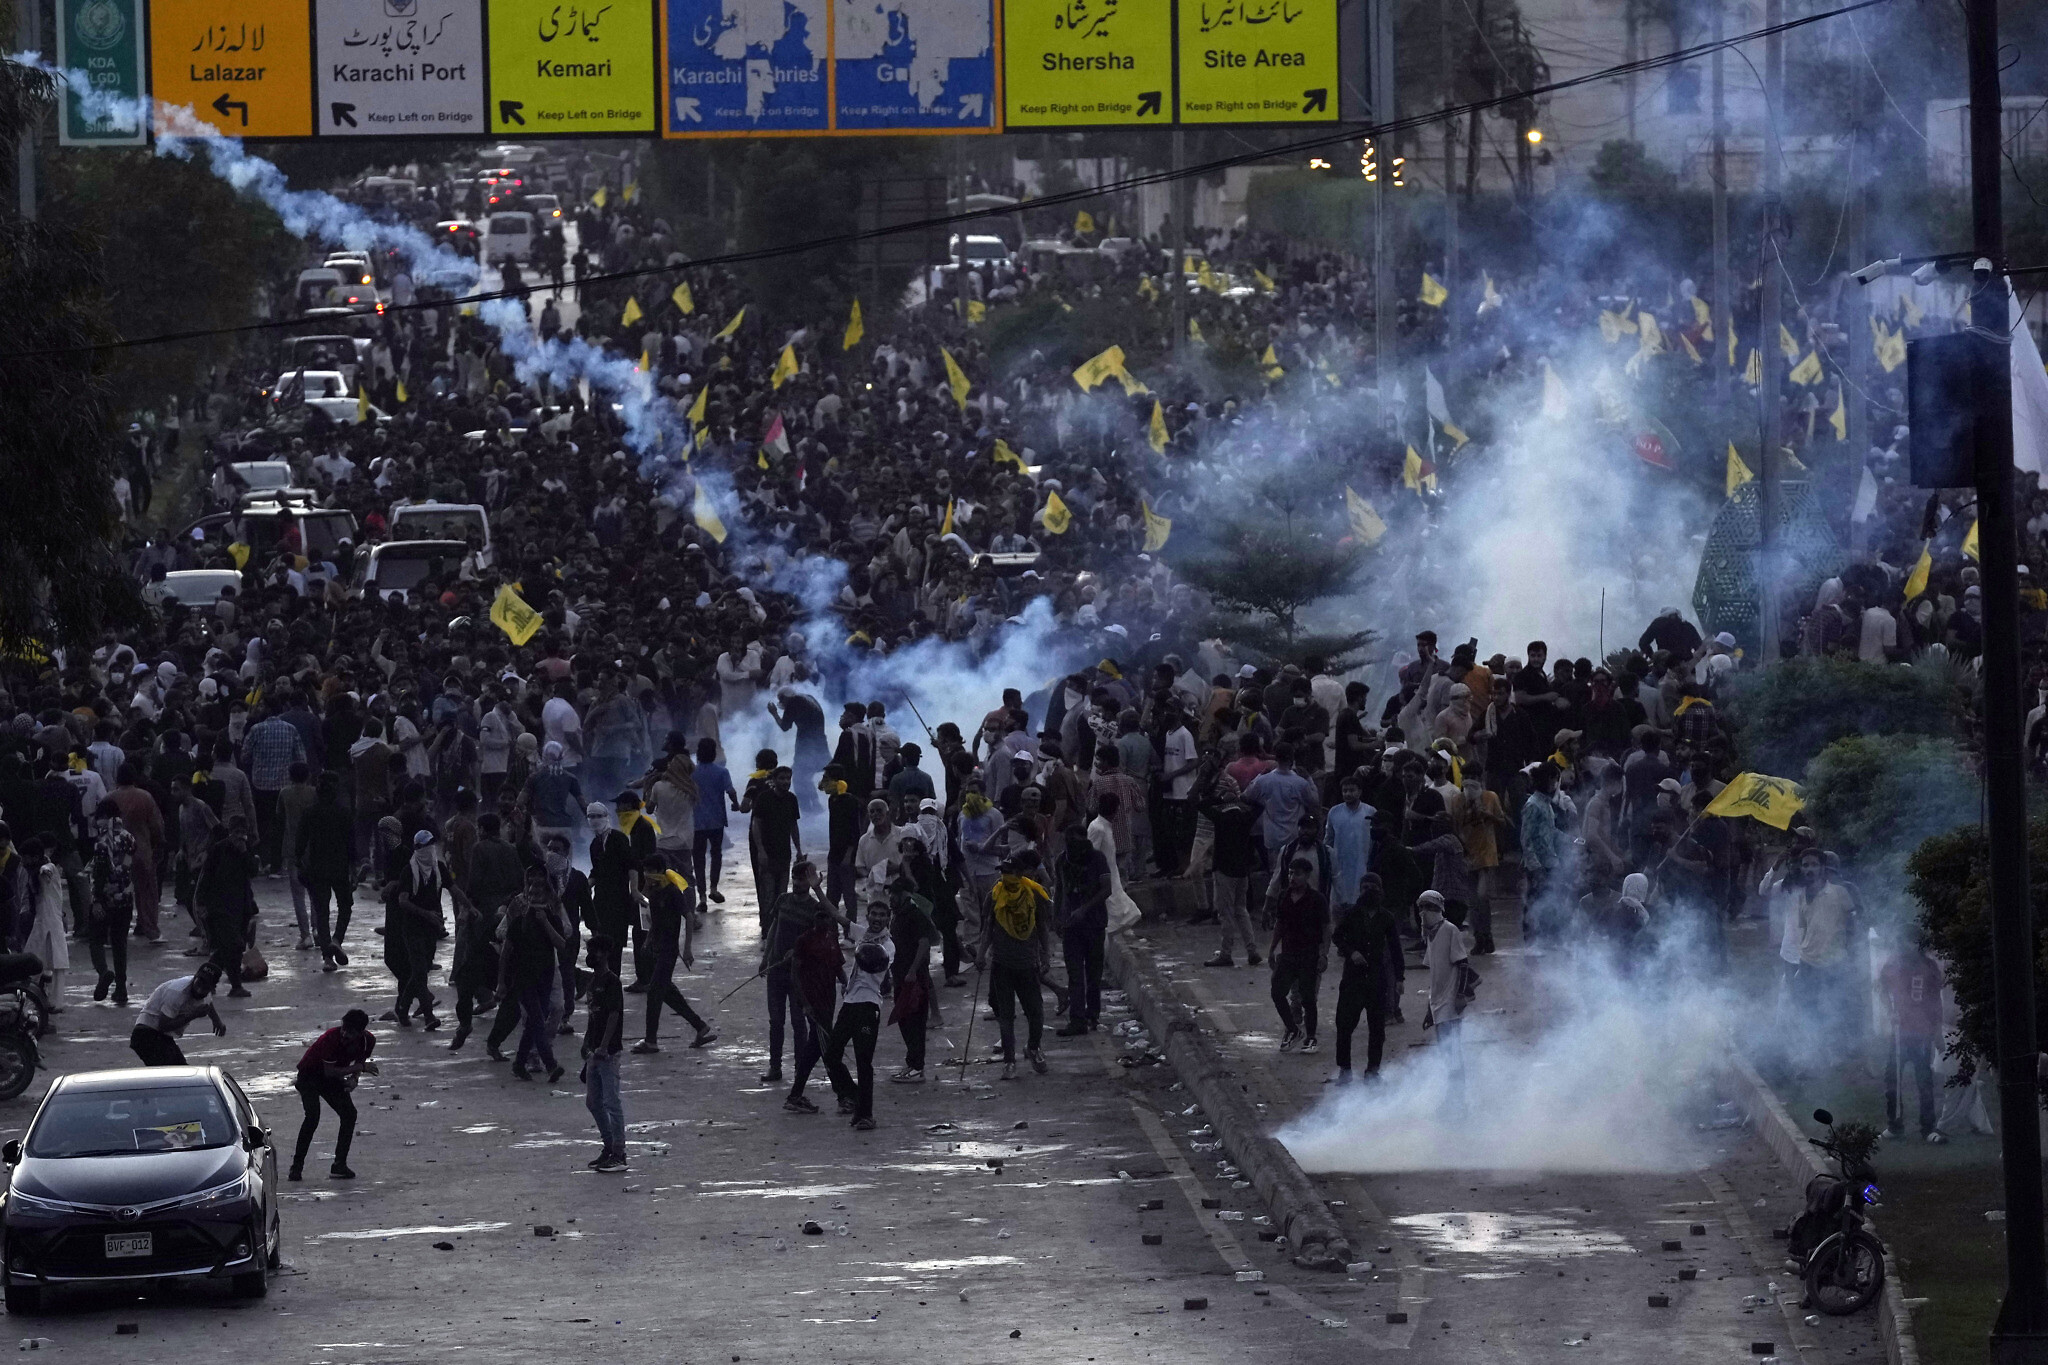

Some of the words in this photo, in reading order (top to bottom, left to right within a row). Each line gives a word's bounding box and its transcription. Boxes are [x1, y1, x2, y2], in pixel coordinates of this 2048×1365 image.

[396, 12, 454, 56] کراچی
[344, 26, 392, 58] پورٹ
[88, 57, 116, 68] KDA
[1042, 52, 1134, 70] Shersha
[1204, 50, 1246, 68] Site
[1254, 49, 1306, 67] Area
[190, 64, 266, 81] Lalazar
[334, 64, 414, 82] Karachi
[422, 63, 466, 81] Port
[538, 59, 612, 78] Kemari
[674, 66, 742, 84] Karachi
[716, 108, 742, 118] Keep
[784, 106, 820, 116] Bridge
[842, 106, 868, 116] Keep
[872, 105, 899, 116] Right
[1020, 104, 1047, 114] Keep
[1050, 104, 1078, 114] Right
[1098, 102, 1132, 114] Bridge
[1186, 102, 1212, 112] Keep
[1216, 100, 1244, 112] Right
[1264, 100, 1298, 110] Bridge
[368, 113, 396, 124] Keep
[398, 112, 418, 122] Left
[438, 112, 473, 122] Bridge
[538, 110, 564, 121] Keep
[568, 110, 588, 119] Left
[607, 110, 642, 120] Bridge
